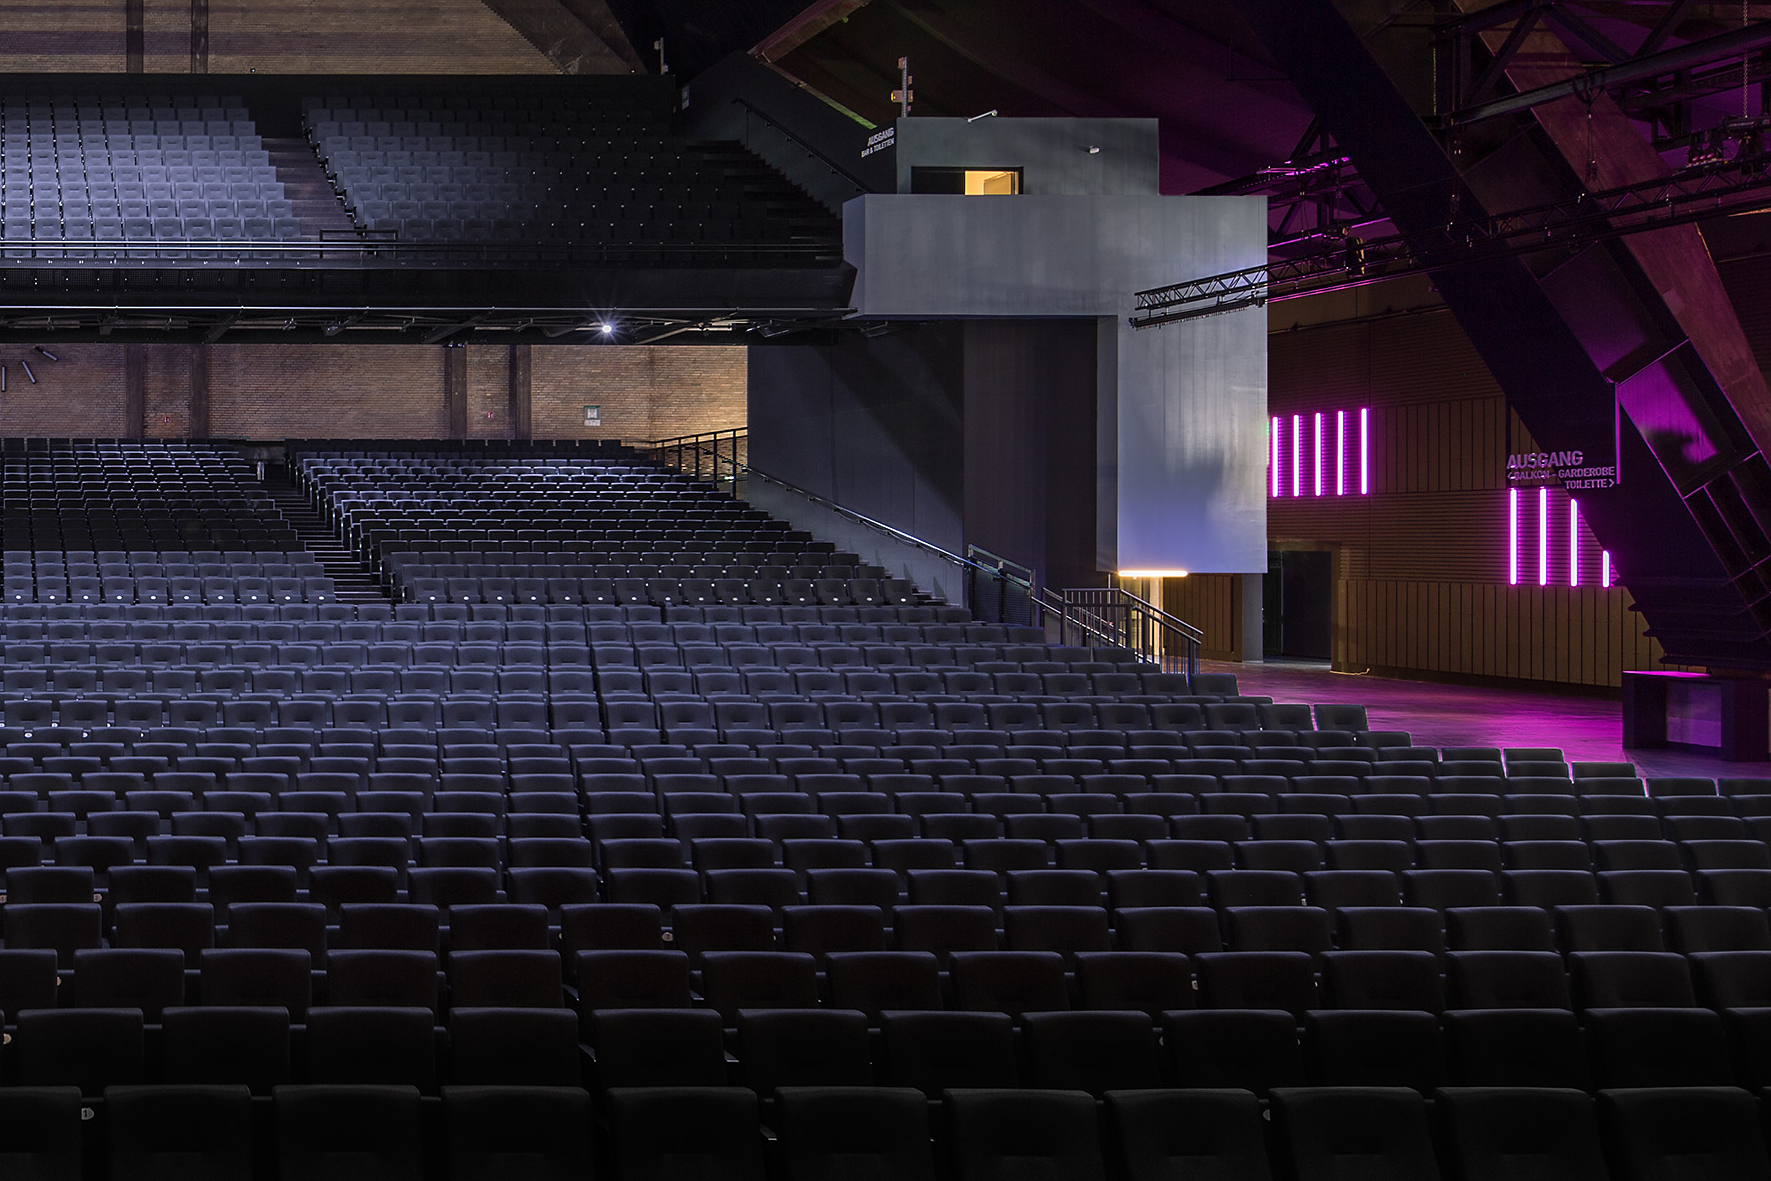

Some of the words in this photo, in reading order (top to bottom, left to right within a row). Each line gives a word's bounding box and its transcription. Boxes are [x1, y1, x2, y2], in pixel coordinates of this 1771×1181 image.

[867, 127, 895, 147] AUSGANG
[1506, 450, 1583, 469] AUSGANG
[1514, 469, 1550, 481] BALKON
[1558, 466, 1615, 478] GARDEROBE
[1564, 479, 1607, 489] TOILETTE
